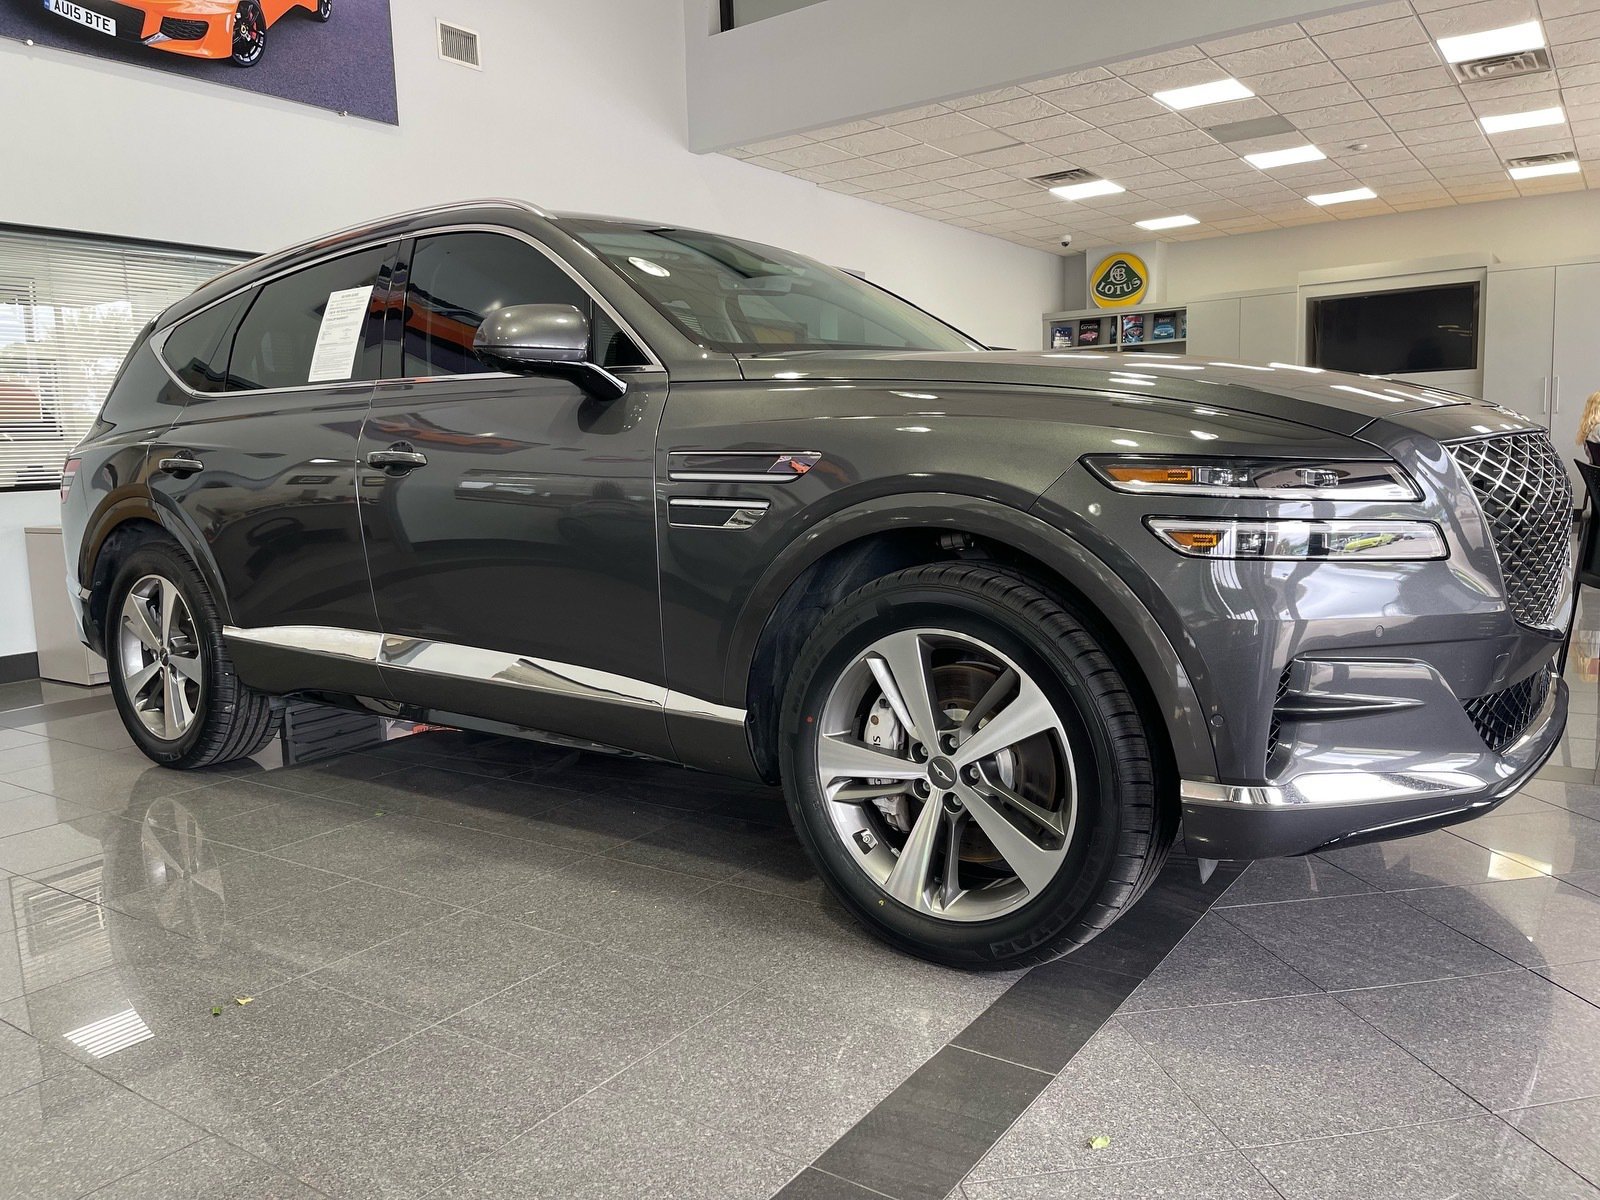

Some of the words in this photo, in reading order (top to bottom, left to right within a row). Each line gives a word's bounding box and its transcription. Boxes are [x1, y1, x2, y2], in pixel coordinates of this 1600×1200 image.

[54, 0, 81, 20] AU15
[85, 11, 111, 32] BTE
[1098, 278, 1140, 294] LOTUS
